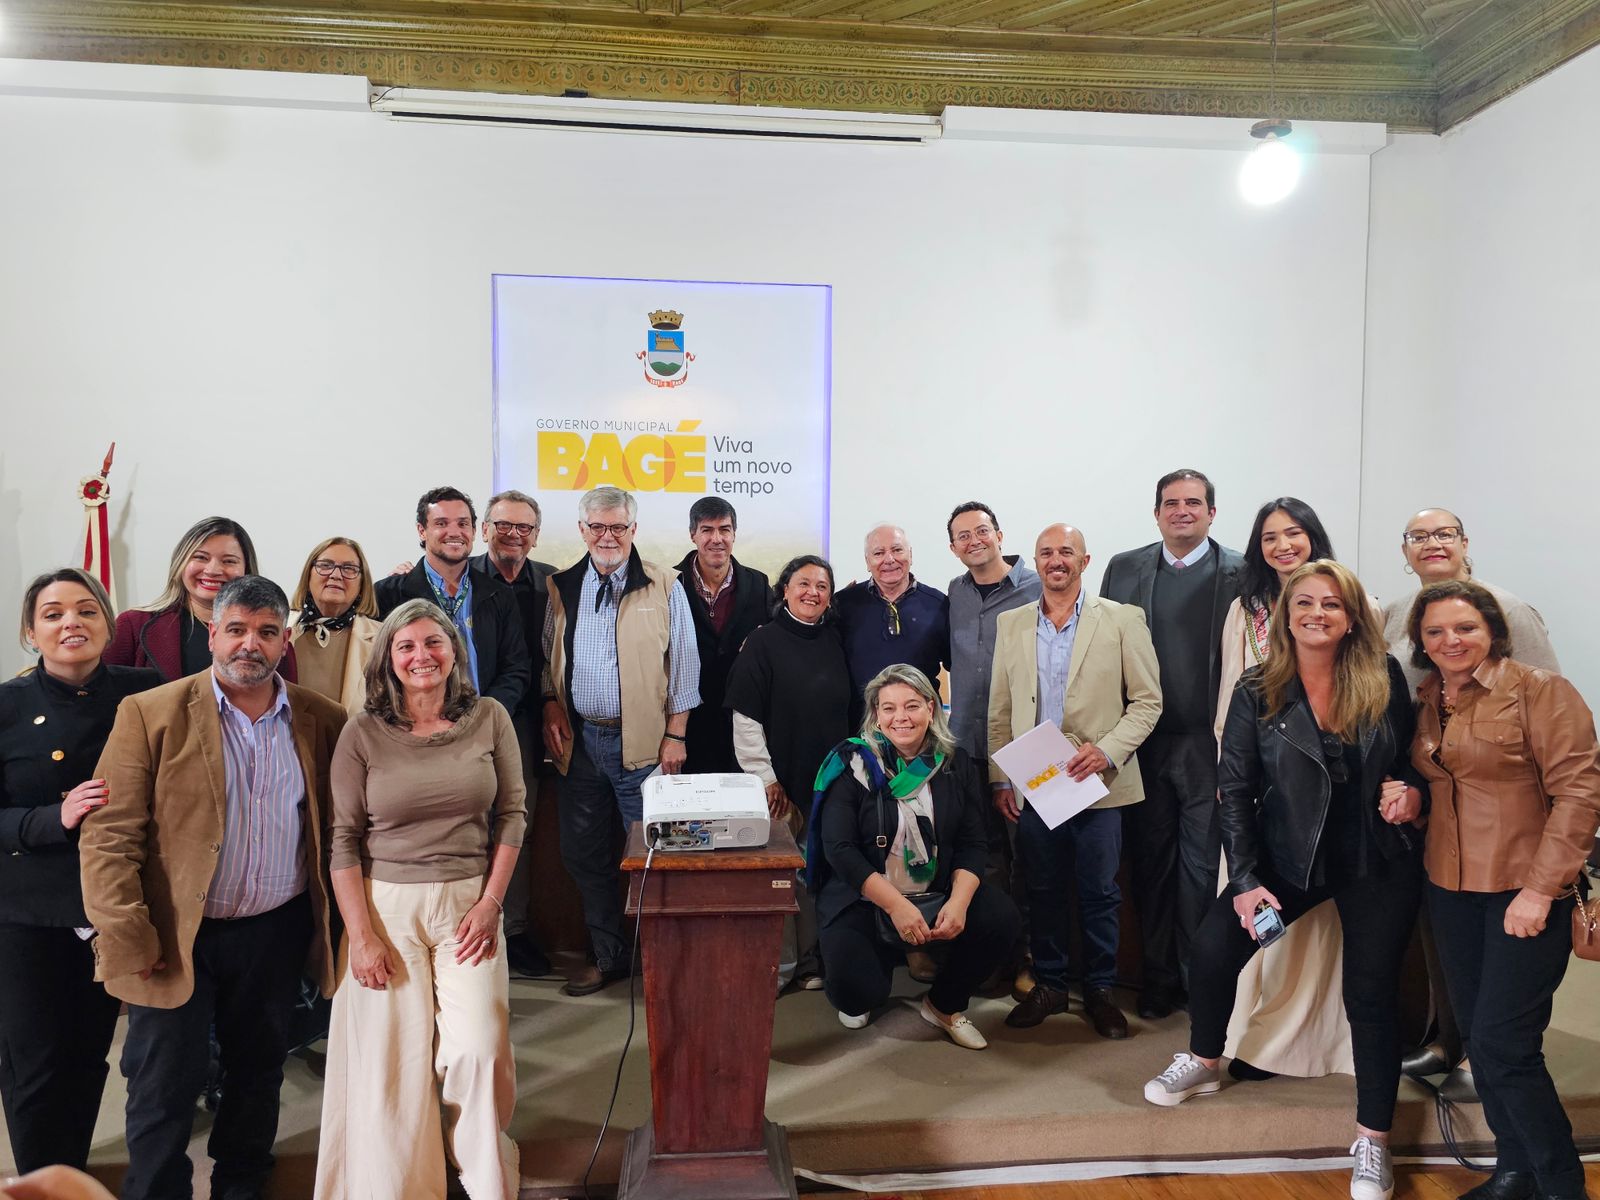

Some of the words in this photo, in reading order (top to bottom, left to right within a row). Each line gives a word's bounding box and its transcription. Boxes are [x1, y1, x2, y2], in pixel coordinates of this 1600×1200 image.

[536, 418, 599, 430] GOVERNO
[604, 420, 673, 432] MUNICIPAL
[713, 435, 753, 454] Viva
[537, 420, 706, 492] BAGÉ
[713, 460, 741, 473] um
[747, 461, 792, 475] novo
[713, 478, 774, 498] tempo
